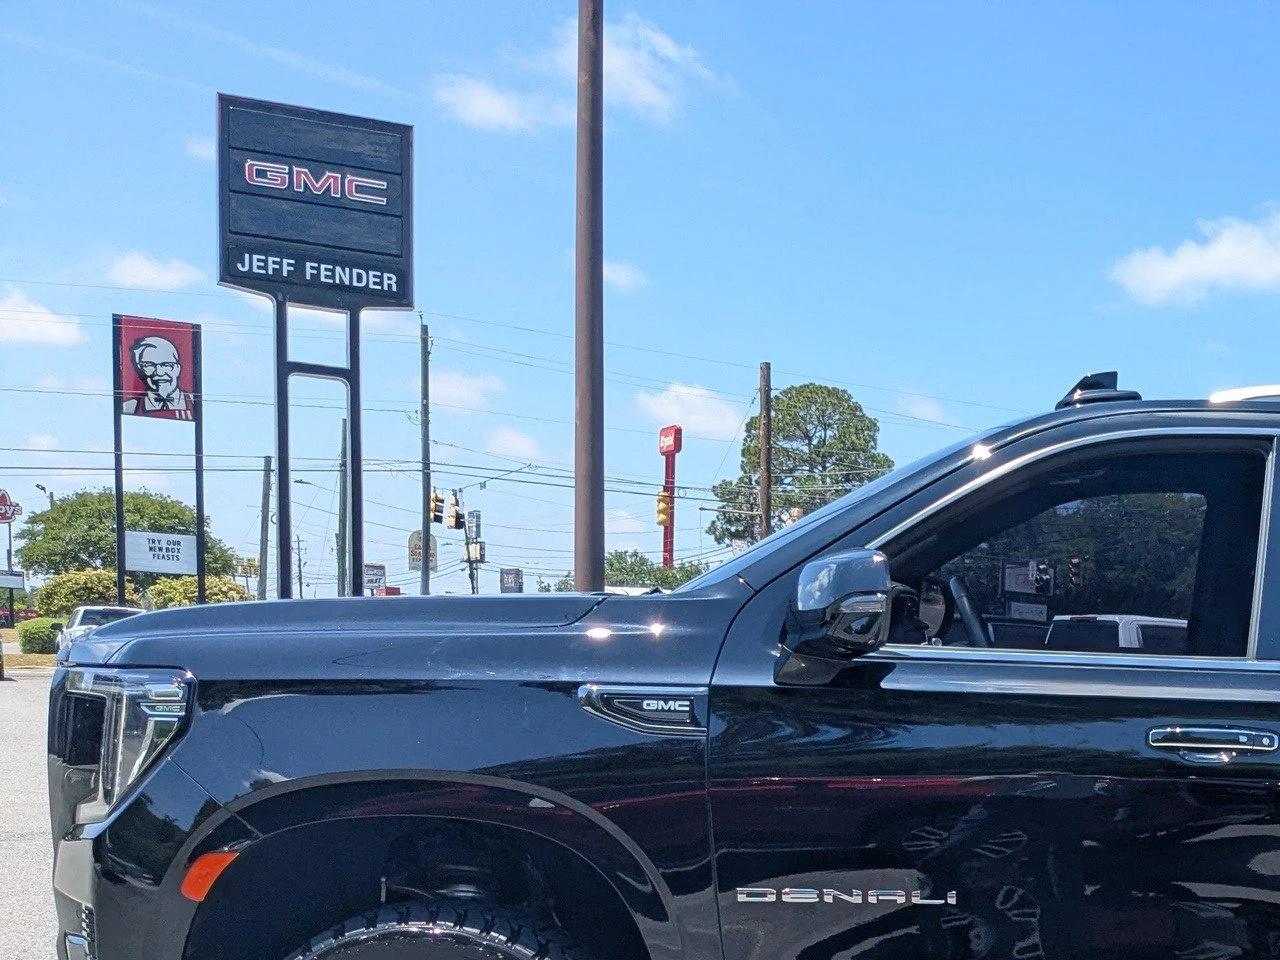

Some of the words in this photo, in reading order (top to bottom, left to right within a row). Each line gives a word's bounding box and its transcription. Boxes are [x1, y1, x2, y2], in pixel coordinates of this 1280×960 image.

[245, 159, 387, 206] GMC
[236, 253, 296, 277] JEFF
[305, 261, 398, 292] FENDER
[642, 700, 690, 711] GMC
[735, 887, 957, 905] DENALI
